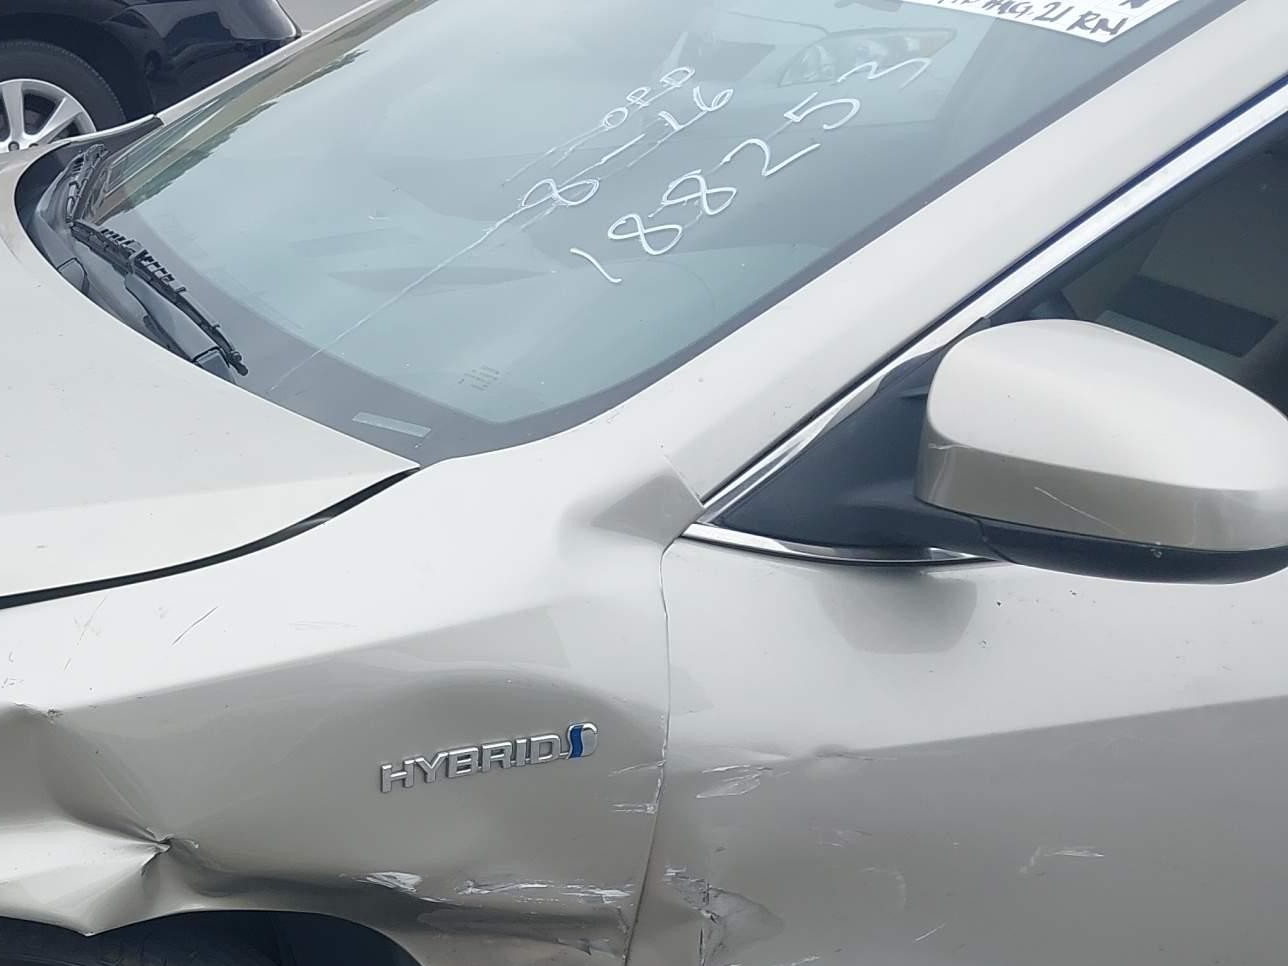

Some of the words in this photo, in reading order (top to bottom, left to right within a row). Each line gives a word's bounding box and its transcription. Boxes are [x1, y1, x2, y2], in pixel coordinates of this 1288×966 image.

[1032, 2, 1074, 22] 21
[569, 58, 930, 282] 188253
[381, 733, 562, 793] HYBRID
